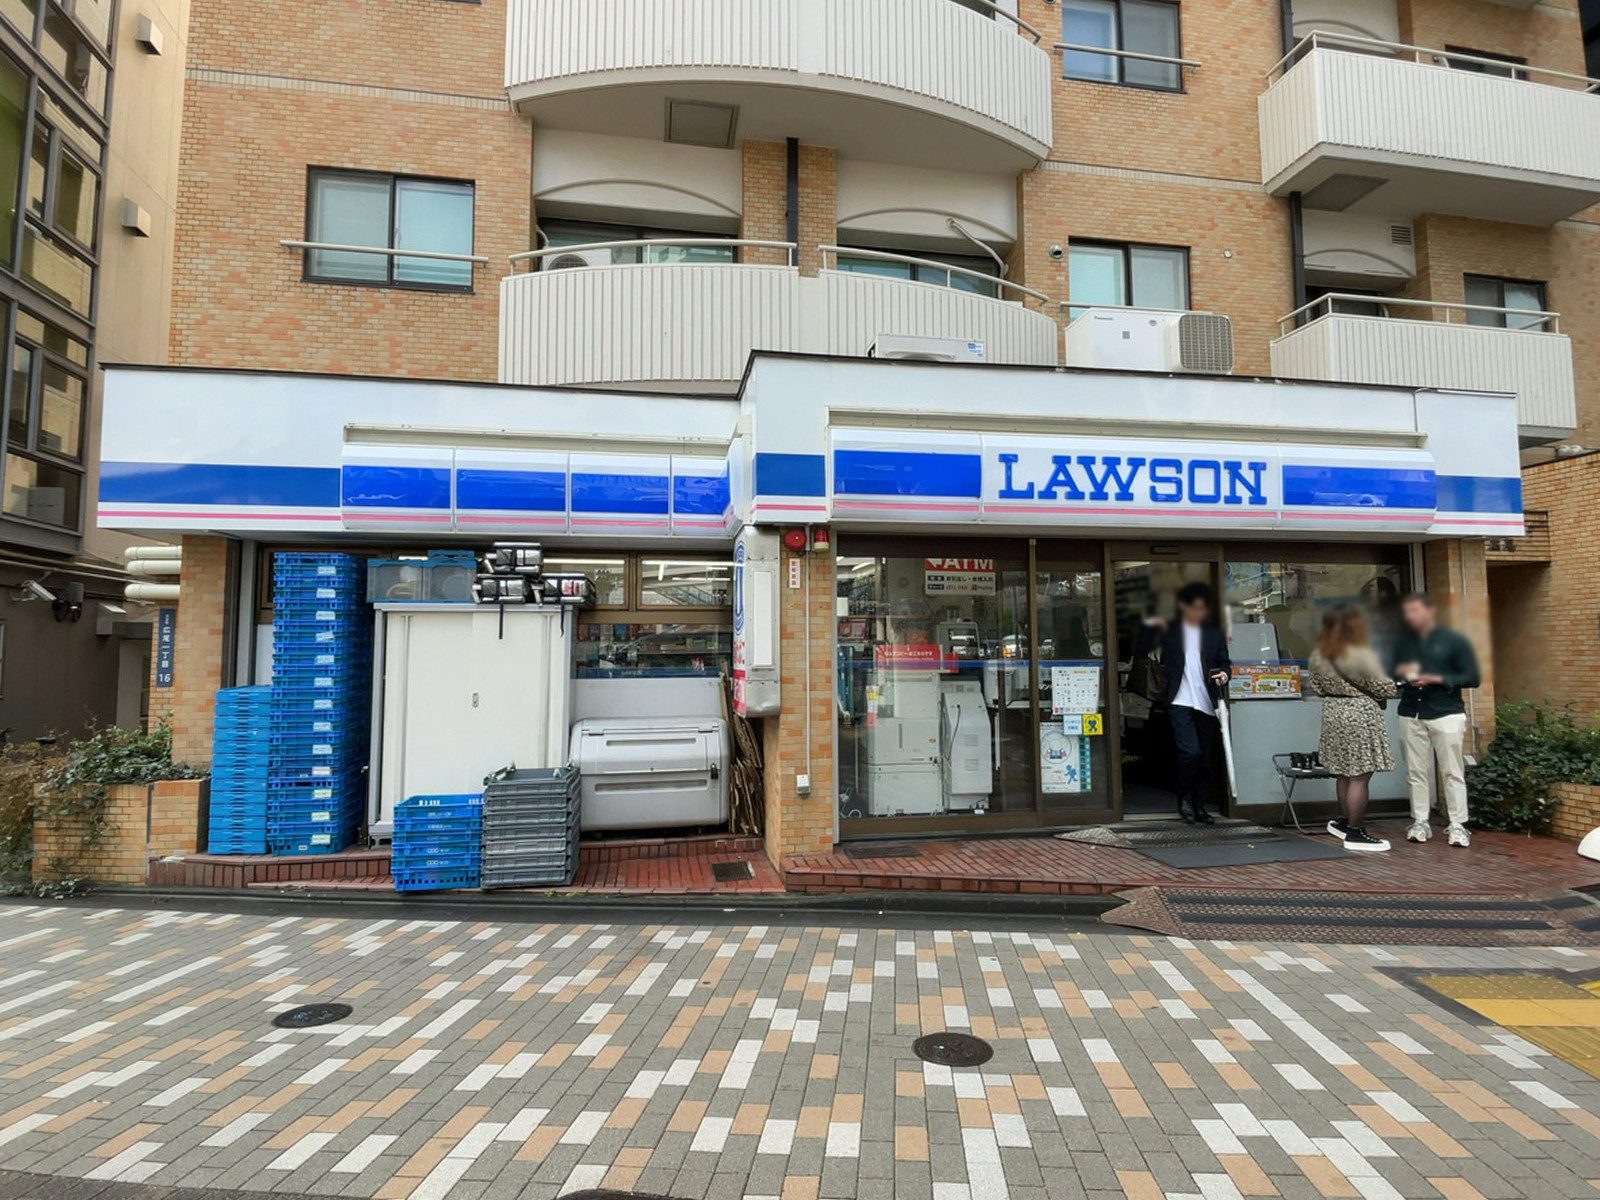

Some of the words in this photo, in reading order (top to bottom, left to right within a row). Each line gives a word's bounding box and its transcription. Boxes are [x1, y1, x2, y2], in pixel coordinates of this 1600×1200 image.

[998, 453, 1268, 505] LAWSON
[943, 559, 993, 569] ATM
[161, 626, 171, 668] 広尾一丁目
[158, 673, 171, 683] 16
